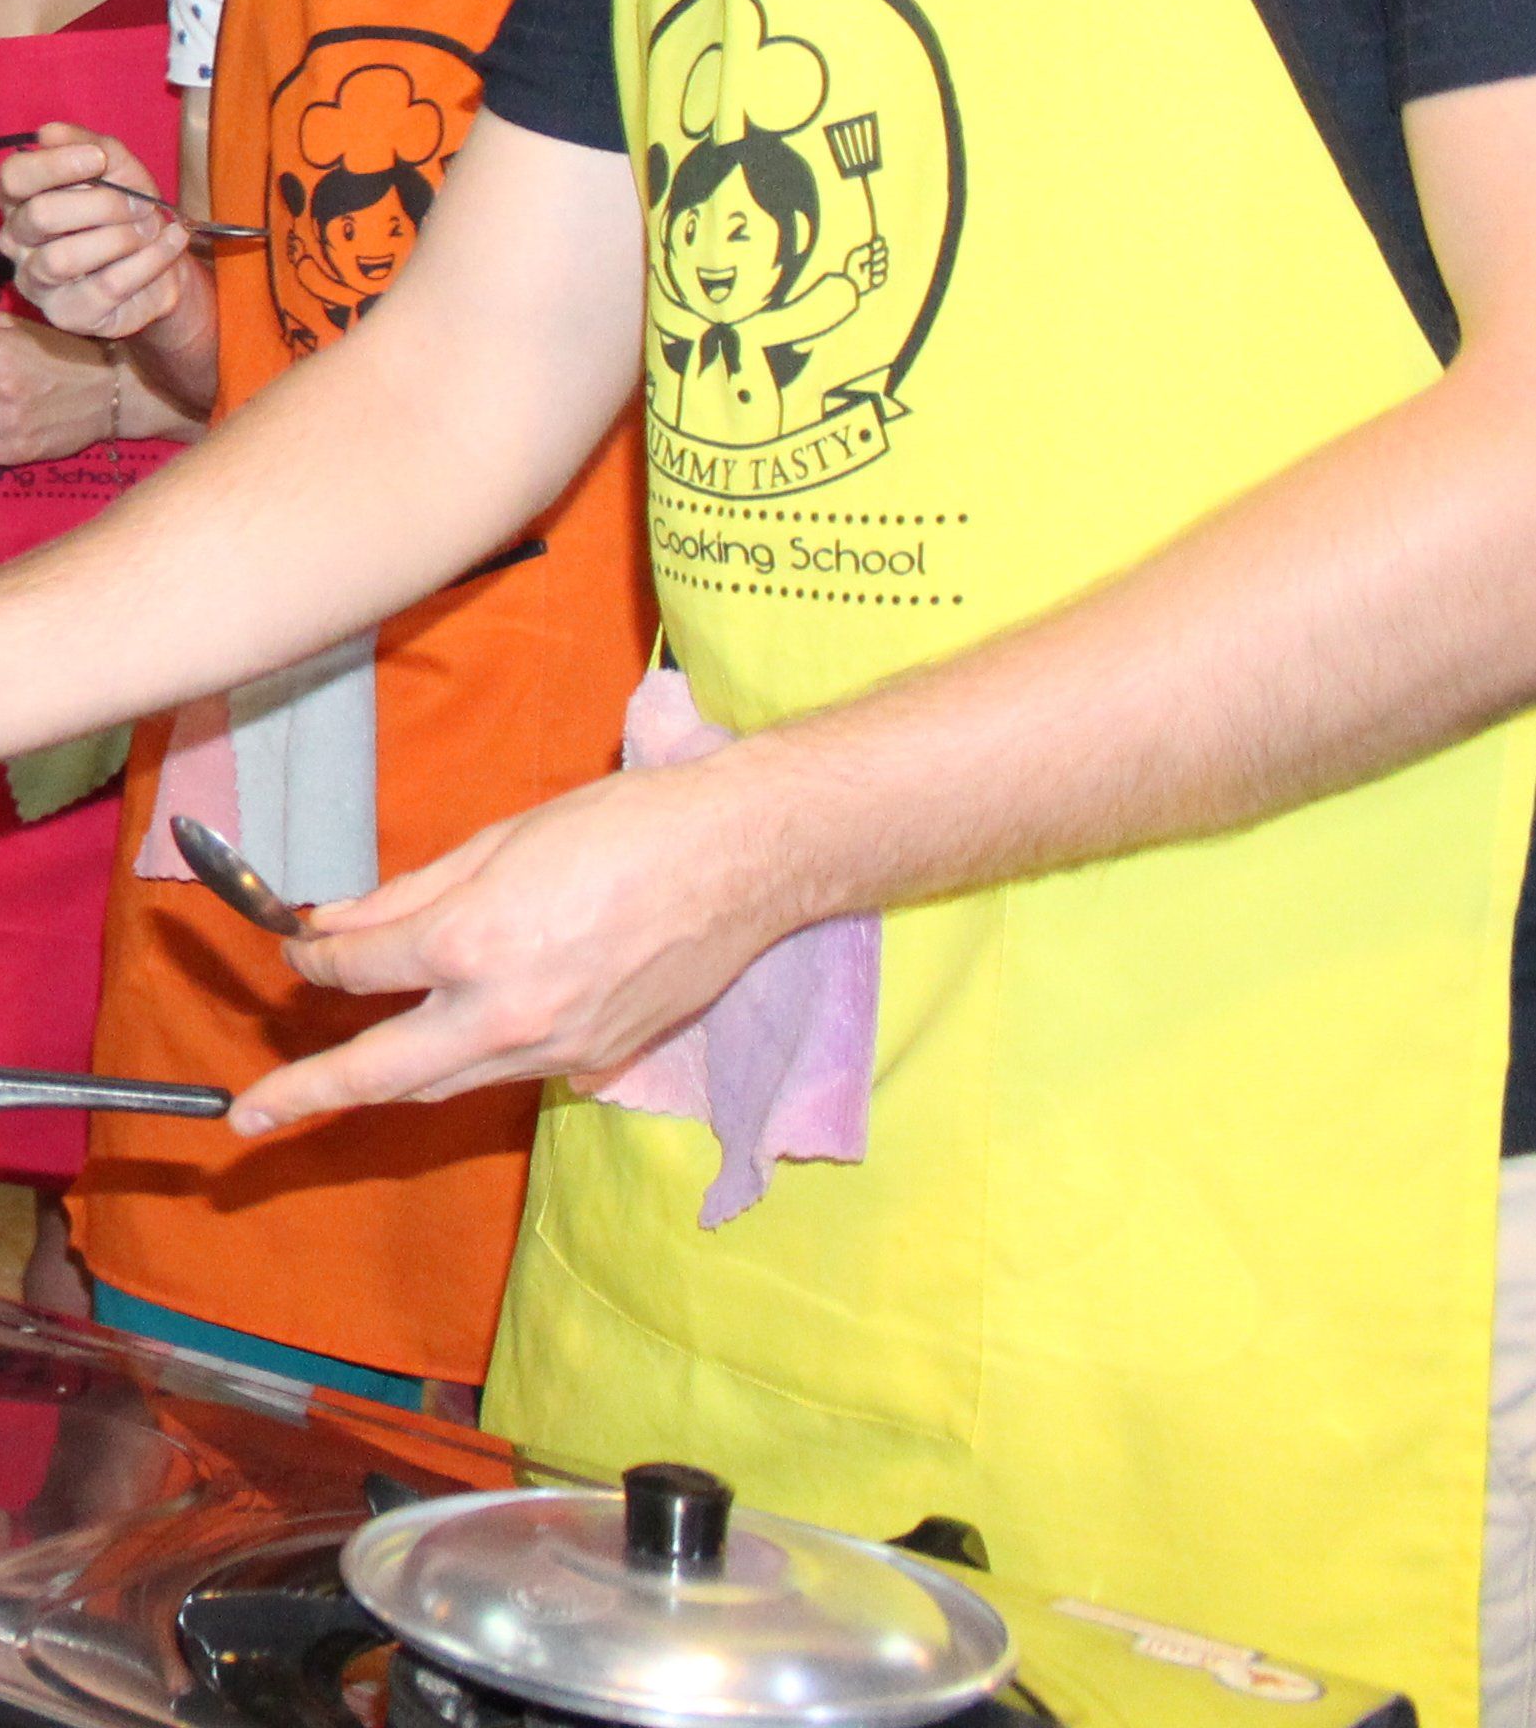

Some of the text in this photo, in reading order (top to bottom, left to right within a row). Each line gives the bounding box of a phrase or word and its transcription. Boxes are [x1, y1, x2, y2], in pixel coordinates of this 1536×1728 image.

[648, 423, 857, 491] UMMY TASTY
[652, 516, 927, 576] Cooking School
